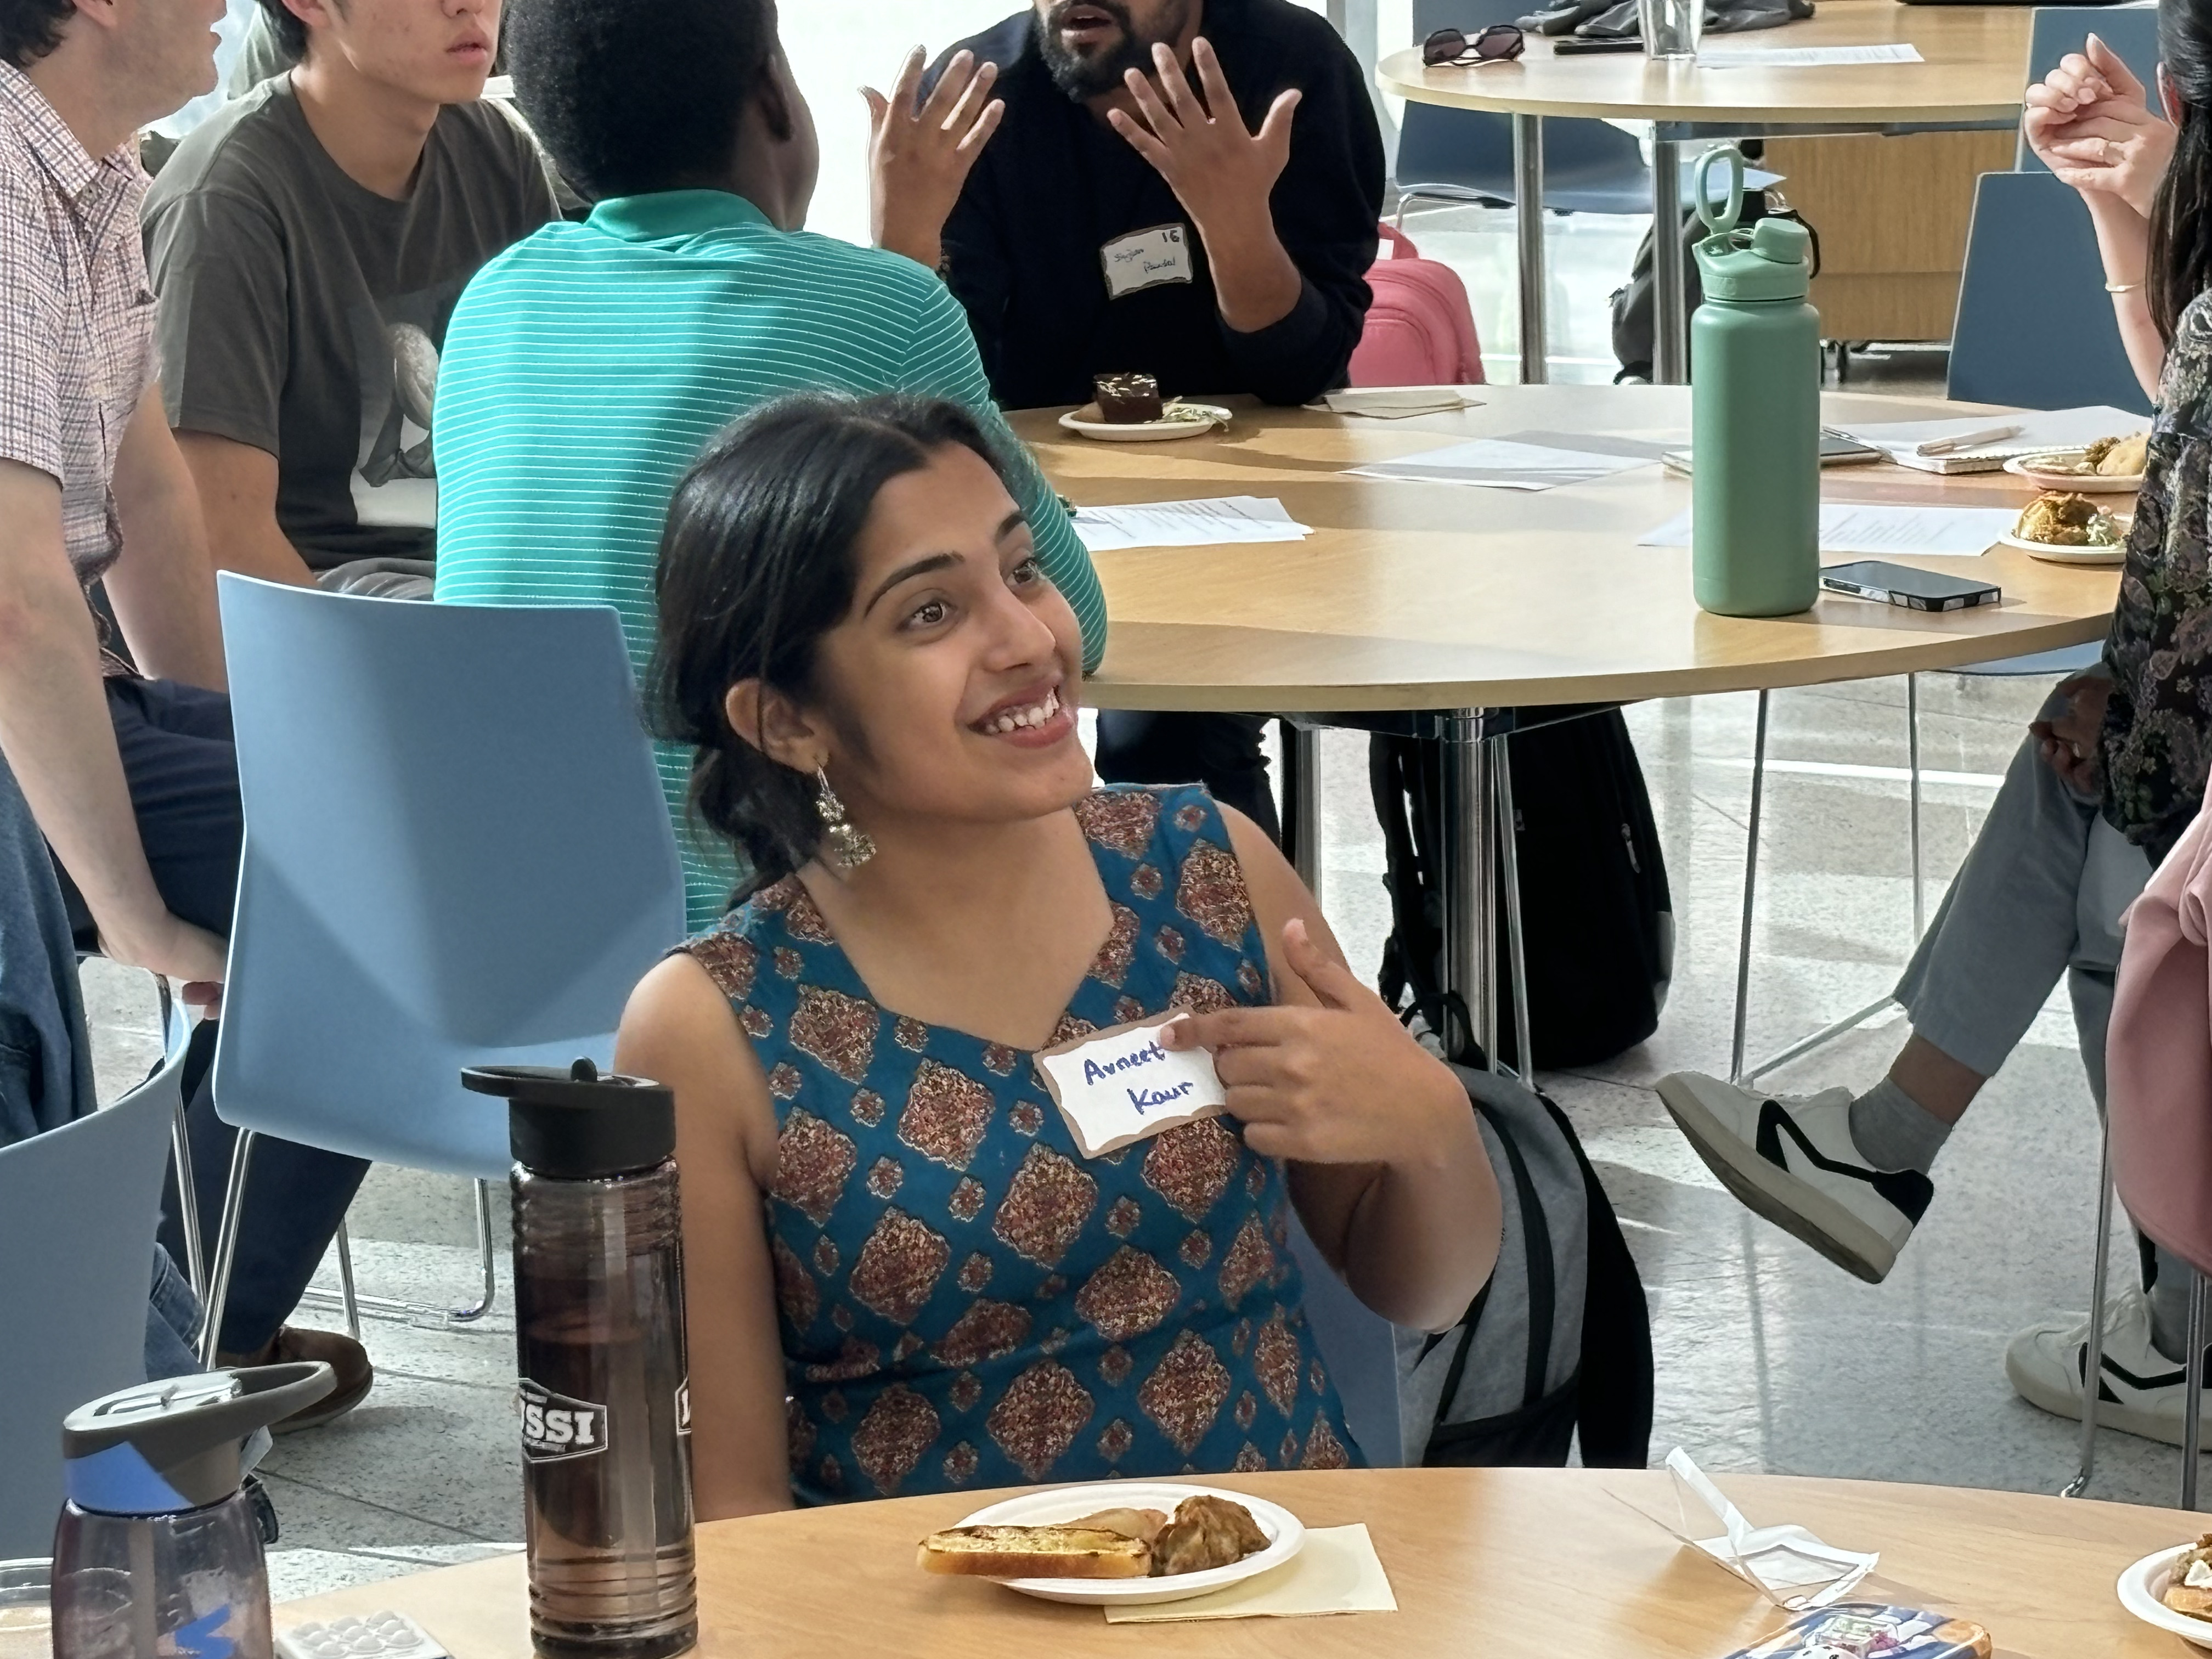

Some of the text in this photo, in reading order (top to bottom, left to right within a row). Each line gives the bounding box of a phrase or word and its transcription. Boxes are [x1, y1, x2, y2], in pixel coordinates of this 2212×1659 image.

[1162, 230, 1180, 242] 16
[1084, 1040, 1165, 1086] Avneet
[1126, 1081, 1193, 1115] Kaur
[521, 1400, 595, 1445] SSI
